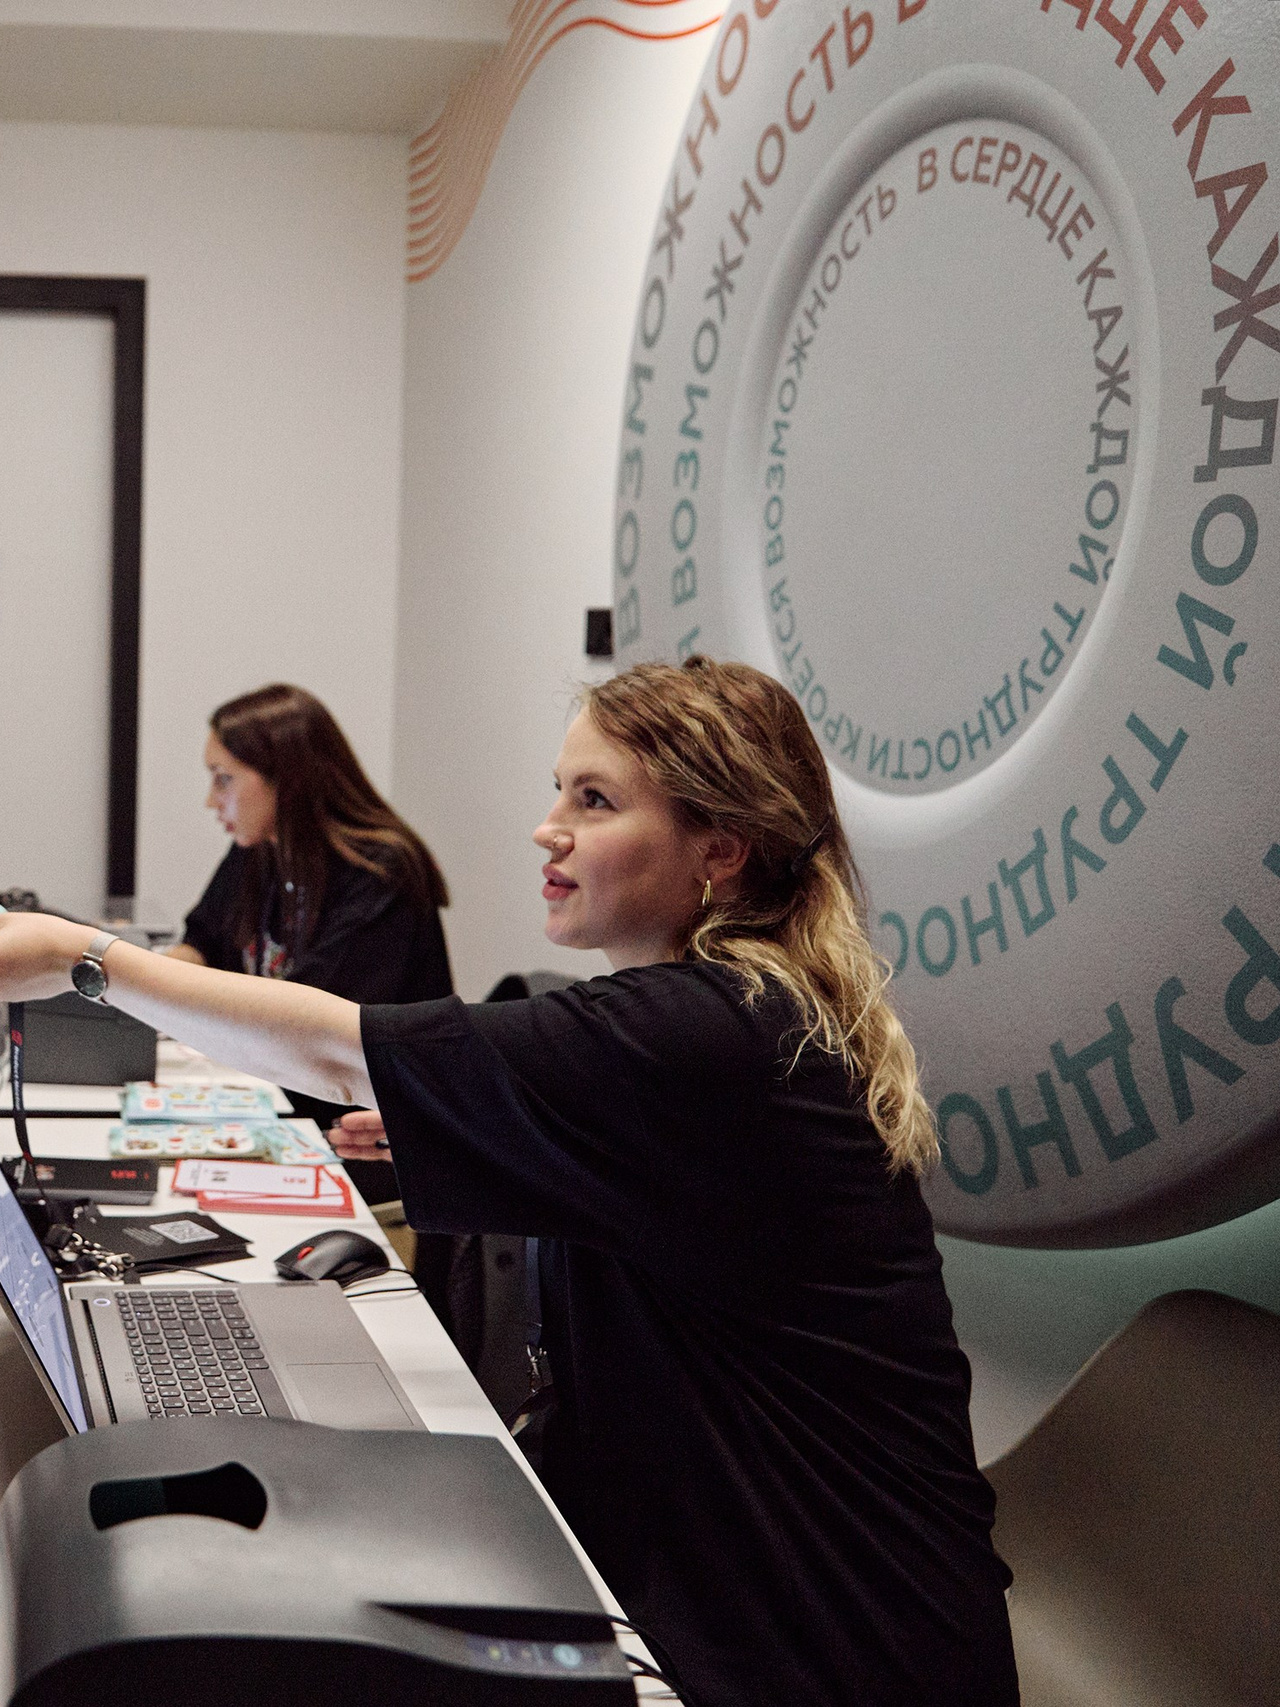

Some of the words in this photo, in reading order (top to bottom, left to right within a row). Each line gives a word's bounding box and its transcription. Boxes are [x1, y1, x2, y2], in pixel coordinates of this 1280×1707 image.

[617, 0, 780, 648] ВОЗМОЖНО
[671, 6, 873, 607] ВОЗМОЖНОСТЬ
[917, 146, 939, 193] В
[950, 136, 1095, 260] СЕРДЦЕ
[764, 184, 898, 567] ВОЗМОЖНОСТЬ
[1069, 248, 1132, 586] КАЖДОЙ
[1156, 57, 1280, 690] КАЖДОЙ
[770, 578, 863, 762] КРОЕТСЯ
[867, 601, 1086, 781] ТРУДНОСТИ
[878, 711, 1190, 979] ТРУДНОС
[935, 843, 1280, 1196] РУДНО
